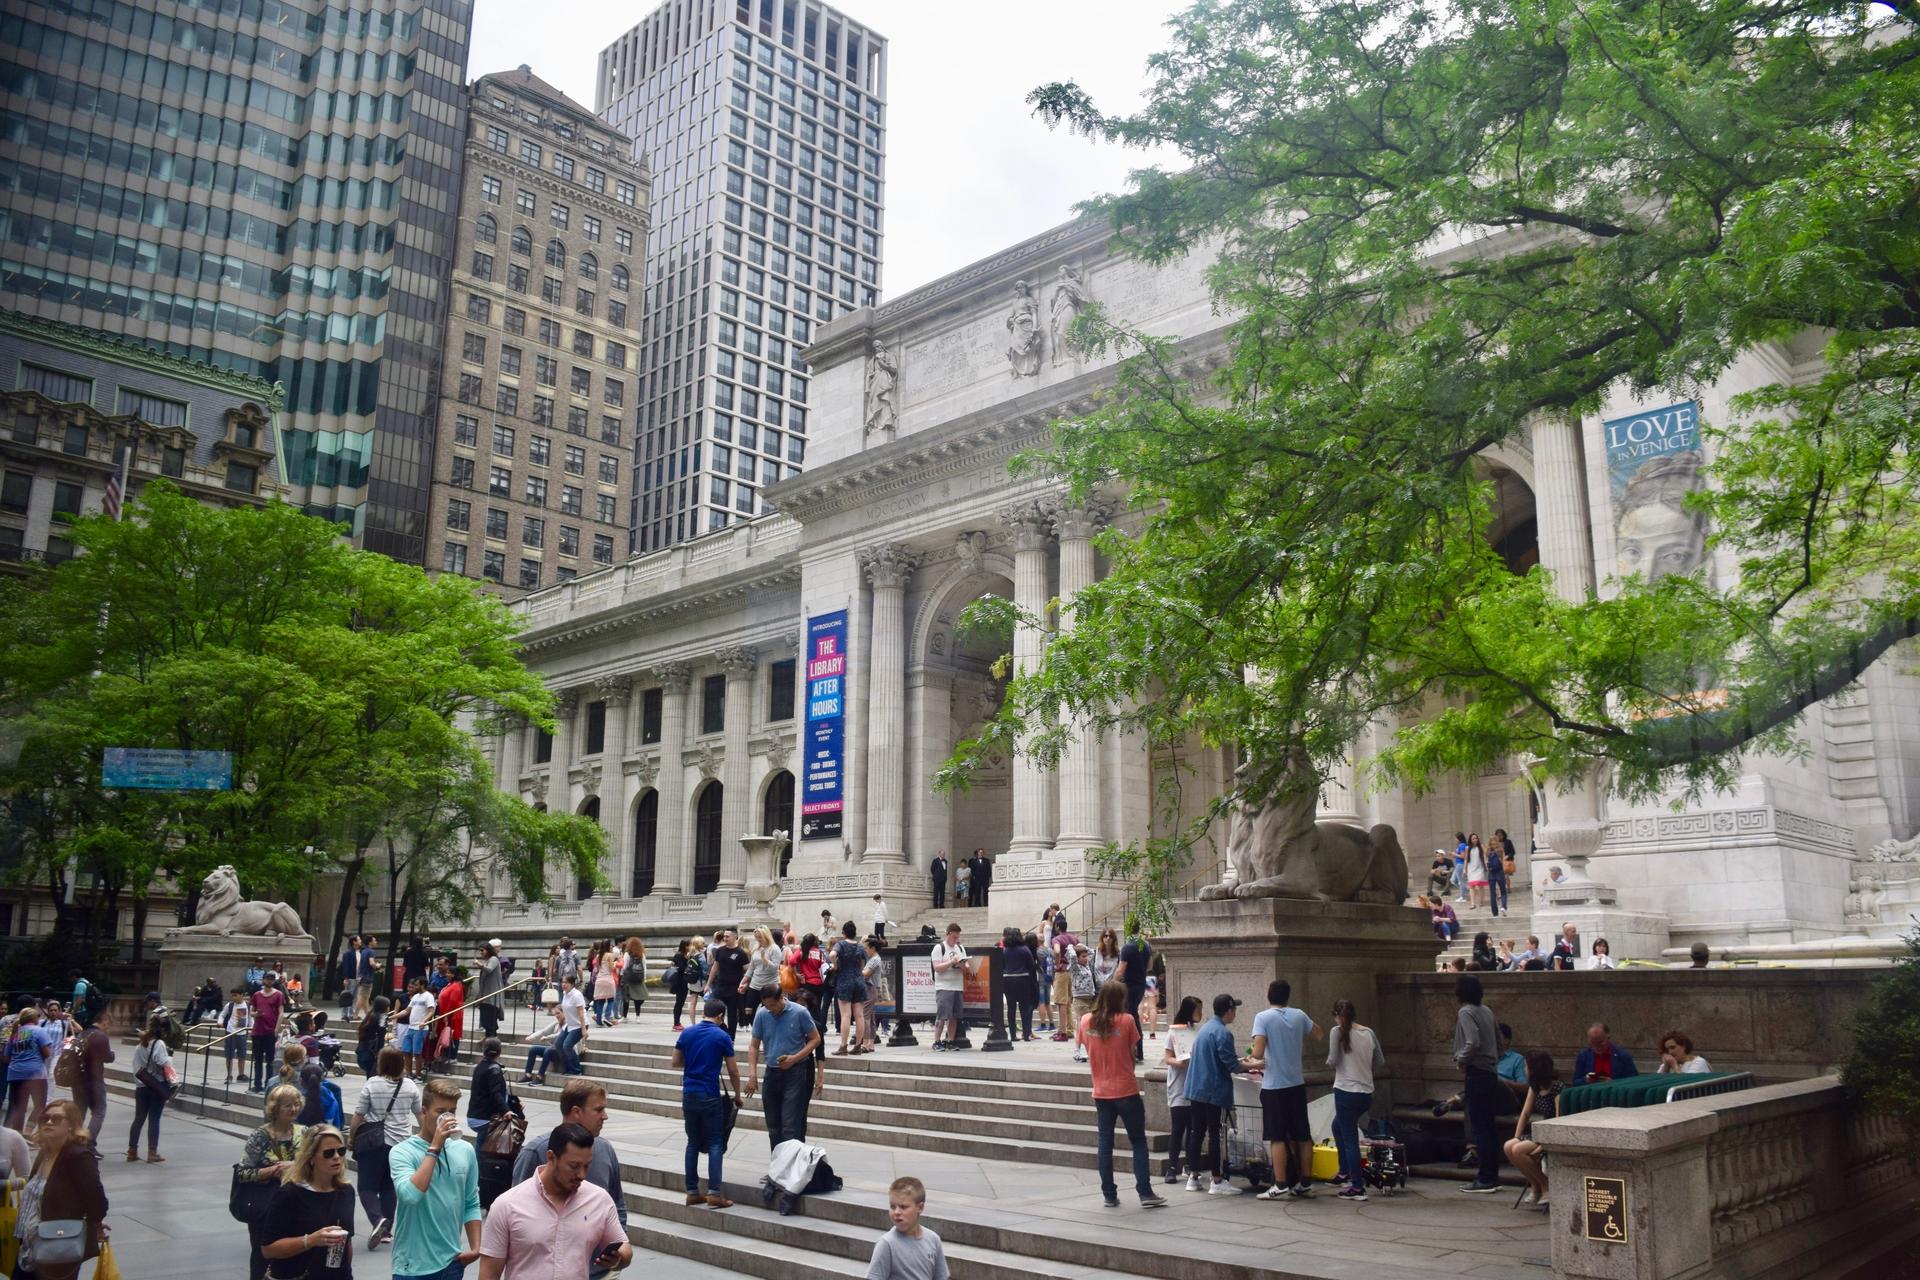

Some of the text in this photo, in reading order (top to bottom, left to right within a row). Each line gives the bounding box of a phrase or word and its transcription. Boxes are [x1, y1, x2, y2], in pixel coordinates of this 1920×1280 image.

[1608, 408, 1694, 449] LOVE
[1618, 433, 1690, 461] IN VENICE
[966, 464, 1004, 491] THE
[813, 620, 842, 632] INTRODUCING
[819, 640, 834, 655] THE
[810, 657, 842, 677] LIBRARY
[813, 679, 838, 697] AFTER
[812, 698, 838, 717] HOURS
[805, 802, 840, 812] SELECT FRIDAYS
[1588, 1193, 1617, 1201] ACCESSIBLE
